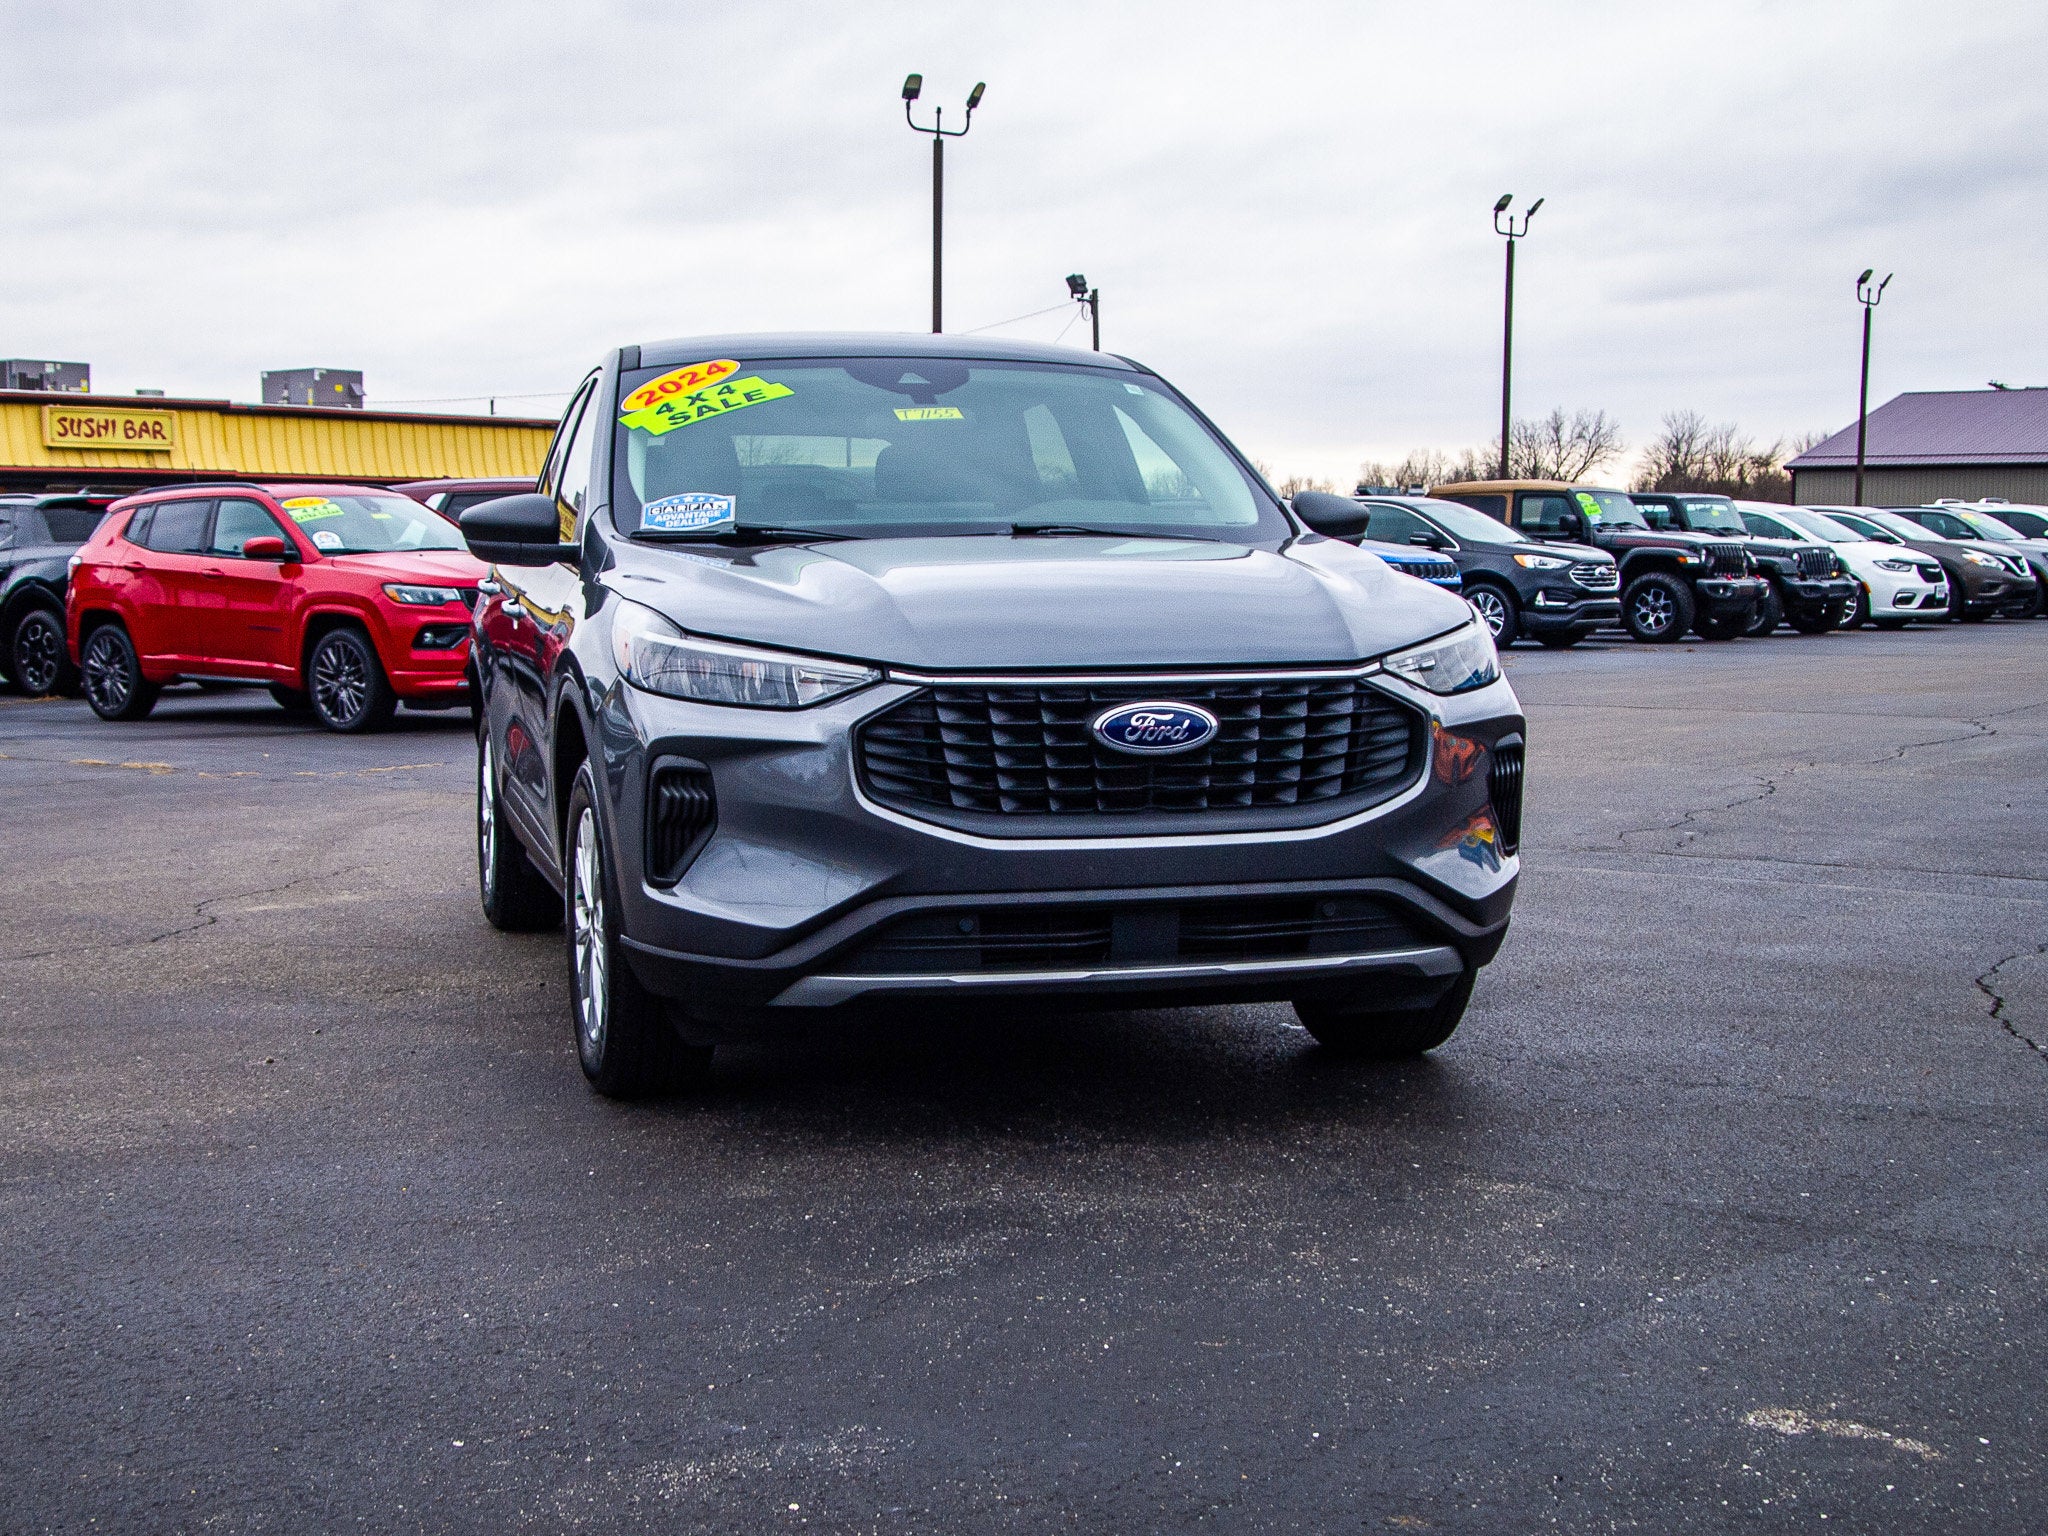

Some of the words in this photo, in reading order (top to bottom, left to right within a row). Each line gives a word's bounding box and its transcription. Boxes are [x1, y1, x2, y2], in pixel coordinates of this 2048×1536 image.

[636, 362, 728, 406] 2024
[668, 388, 766, 426] SALE
[57, 416, 117, 438] SUSHI
[123, 419, 167, 440] BAR
[649, 501, 728, 515] CARFAX
[654, 509, 722, 522] ADVANTAGE
[665, 517, 709, 528] DEALER
[1125, 712, 1191, 741] Ford
